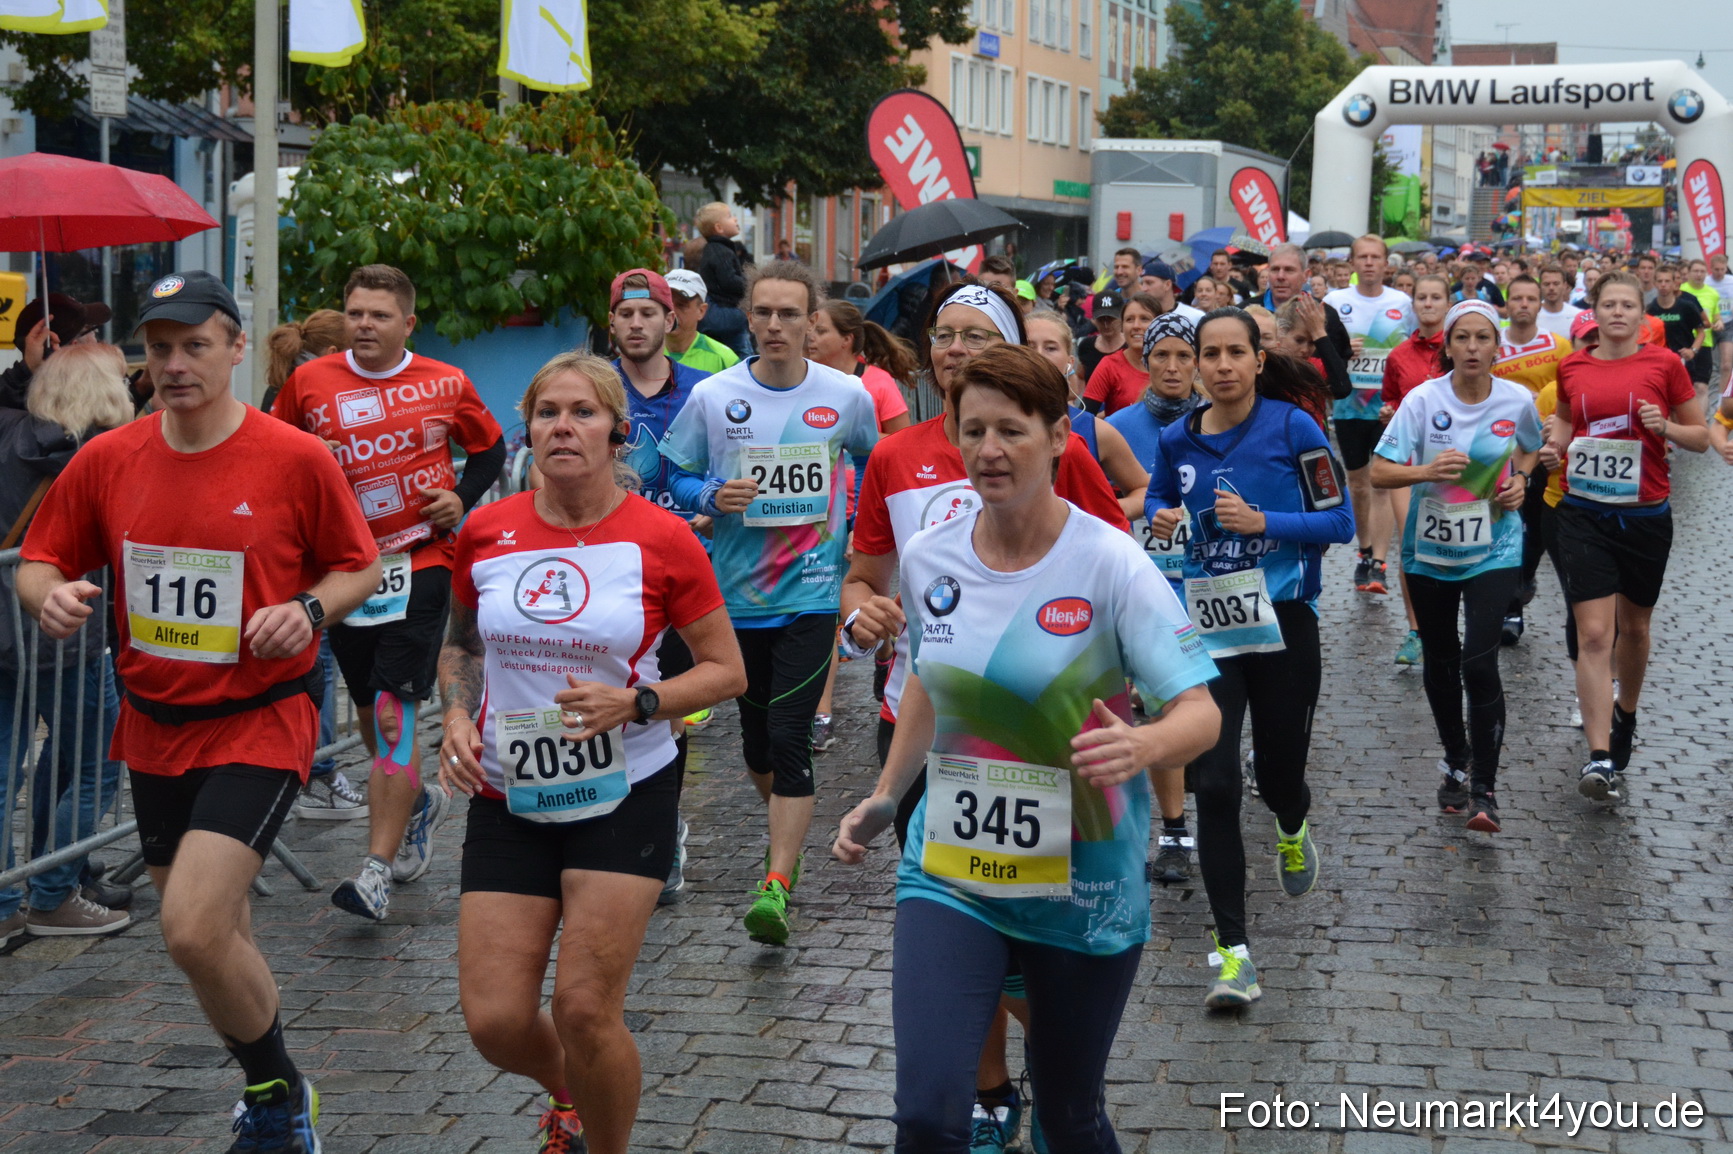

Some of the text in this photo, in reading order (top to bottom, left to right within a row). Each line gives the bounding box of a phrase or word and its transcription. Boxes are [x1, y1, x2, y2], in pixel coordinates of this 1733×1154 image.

[1389, 77, 1655, 109] BMW Laufsport
[1577, 191, 1609, 204] ZIEL
[1689, 170, 1720, 254] REWE
[1494, 353, 1559, 377] MAX BÖGL
[339, 387, 377, 403] raumbox
[392, 402, 436, 418] schenken
[808, 411, 836, 424] Hervis
[726, 427, 754, 435] PARTL
[1599, 421, 1617, 430] DEHN
[1430, 433, 1453, 441] PARTL
[779, 445, 822, 457] BOCK
[377, 451, 417, 468] outdoor
[1574, 451, 1634, 480] 2132
[751, 462, 823, 495] 2466
[916, 472, 937, 480] erima
[358, 477, 395, 493] raumbox
[1586, 482, 1617, 495] Kristin
[762, 500, 813, 515] Christian
[1423, 514, 1483, 543] 2517
[497, 538, 517, 546] erima
[802, 553, 821, 567] 17.
[1435, 546, 1468, 558] Sabine
[130, 552, 232, 569] NeuerMarkt BOCK
[1211, 560, 1251, 570] BASKETS
[1213, 573, 1258, 590] BOCK
[145, 573, 217, 619] 116
[362, 603, 388, 615] Claus
[1045, 606, 1089, 627] Hervis
[1196, 591, 1261, 629] 3037
[155, 626, 199, 646] Alfred
[484, 629, 531, 644] LAUFEN
[571, 638, 609, 654] HERZ
[497, 647, 509, 656] Dr.
[511, 649, 535, 657] Heck
[544, 650, 559, 659] Dr.
[561, 651, 594, 662] Röschl
[500, 660, 593, 675] Leistungsdiagnostik
[505, 722, 538, 732] NeuerMarkt
[509, 731, 613, 780] 2030
[938, 767, 979, 781] NeuerMarkt
[987, 764, 1057, 787] BOCK
[537, 786, 597, 808] Annette
[953, 789, 1041, 849] 345
[970, 856, 1017, 879] Petra
